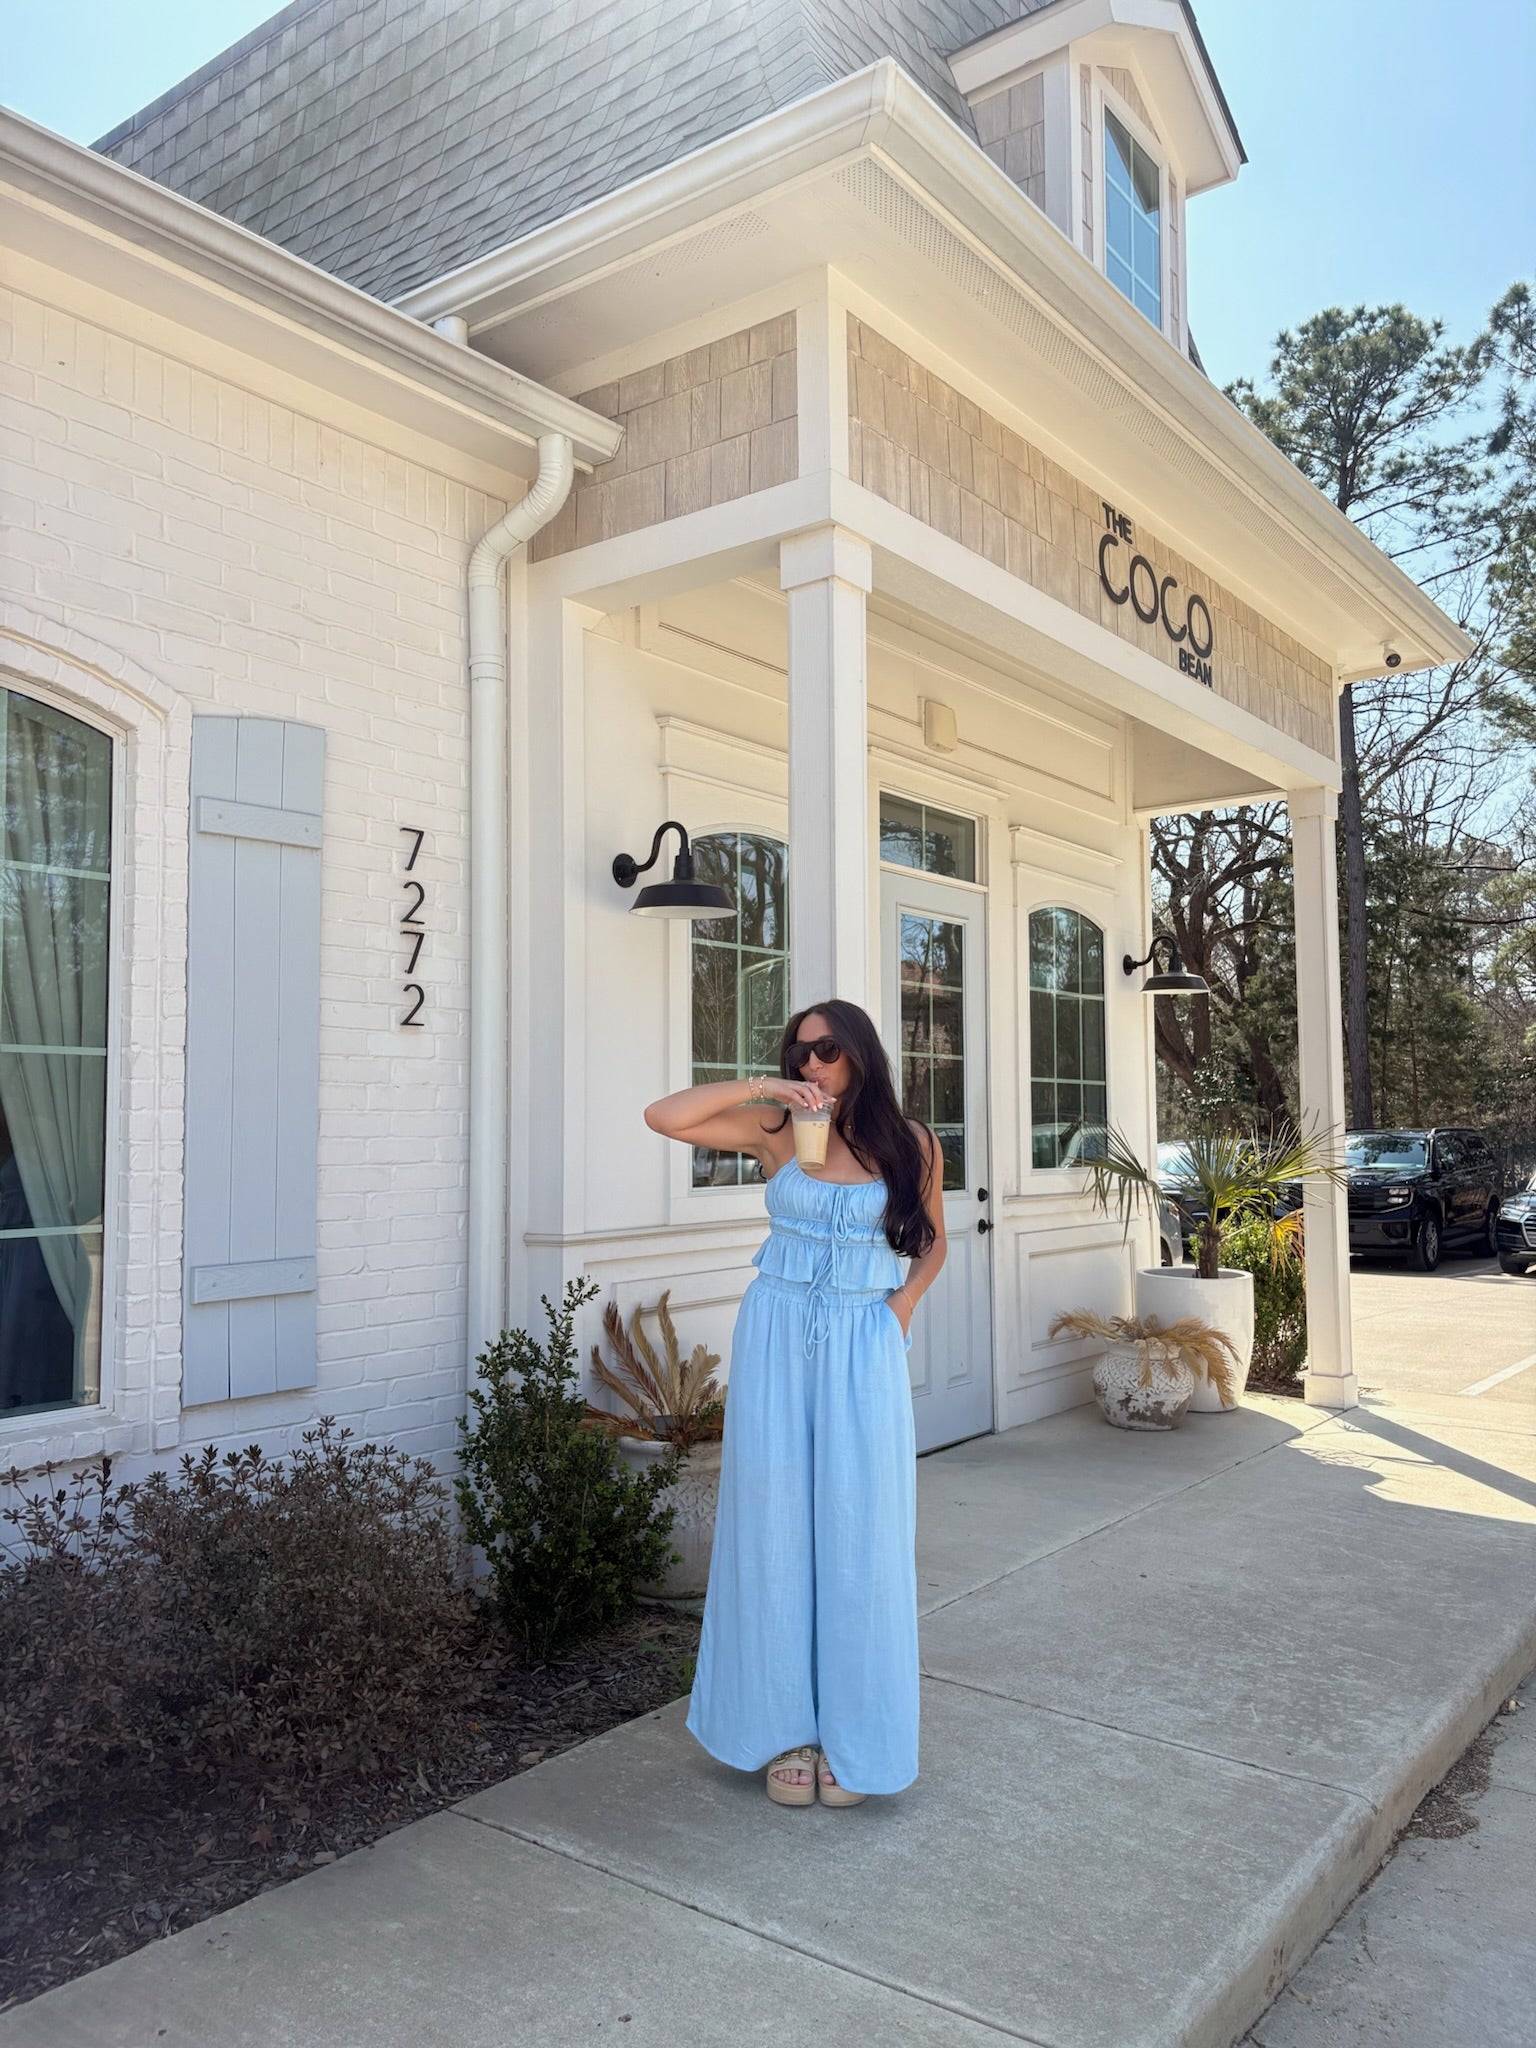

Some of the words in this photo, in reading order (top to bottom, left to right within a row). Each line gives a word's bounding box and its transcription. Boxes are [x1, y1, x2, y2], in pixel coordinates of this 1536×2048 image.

[1102, 502, 1132, 544] THE
[1099, 534, 1213, 658] COCO
[1179, 648, 1212, 687] BEAN
[400, 828, 425, 1026] 7272
